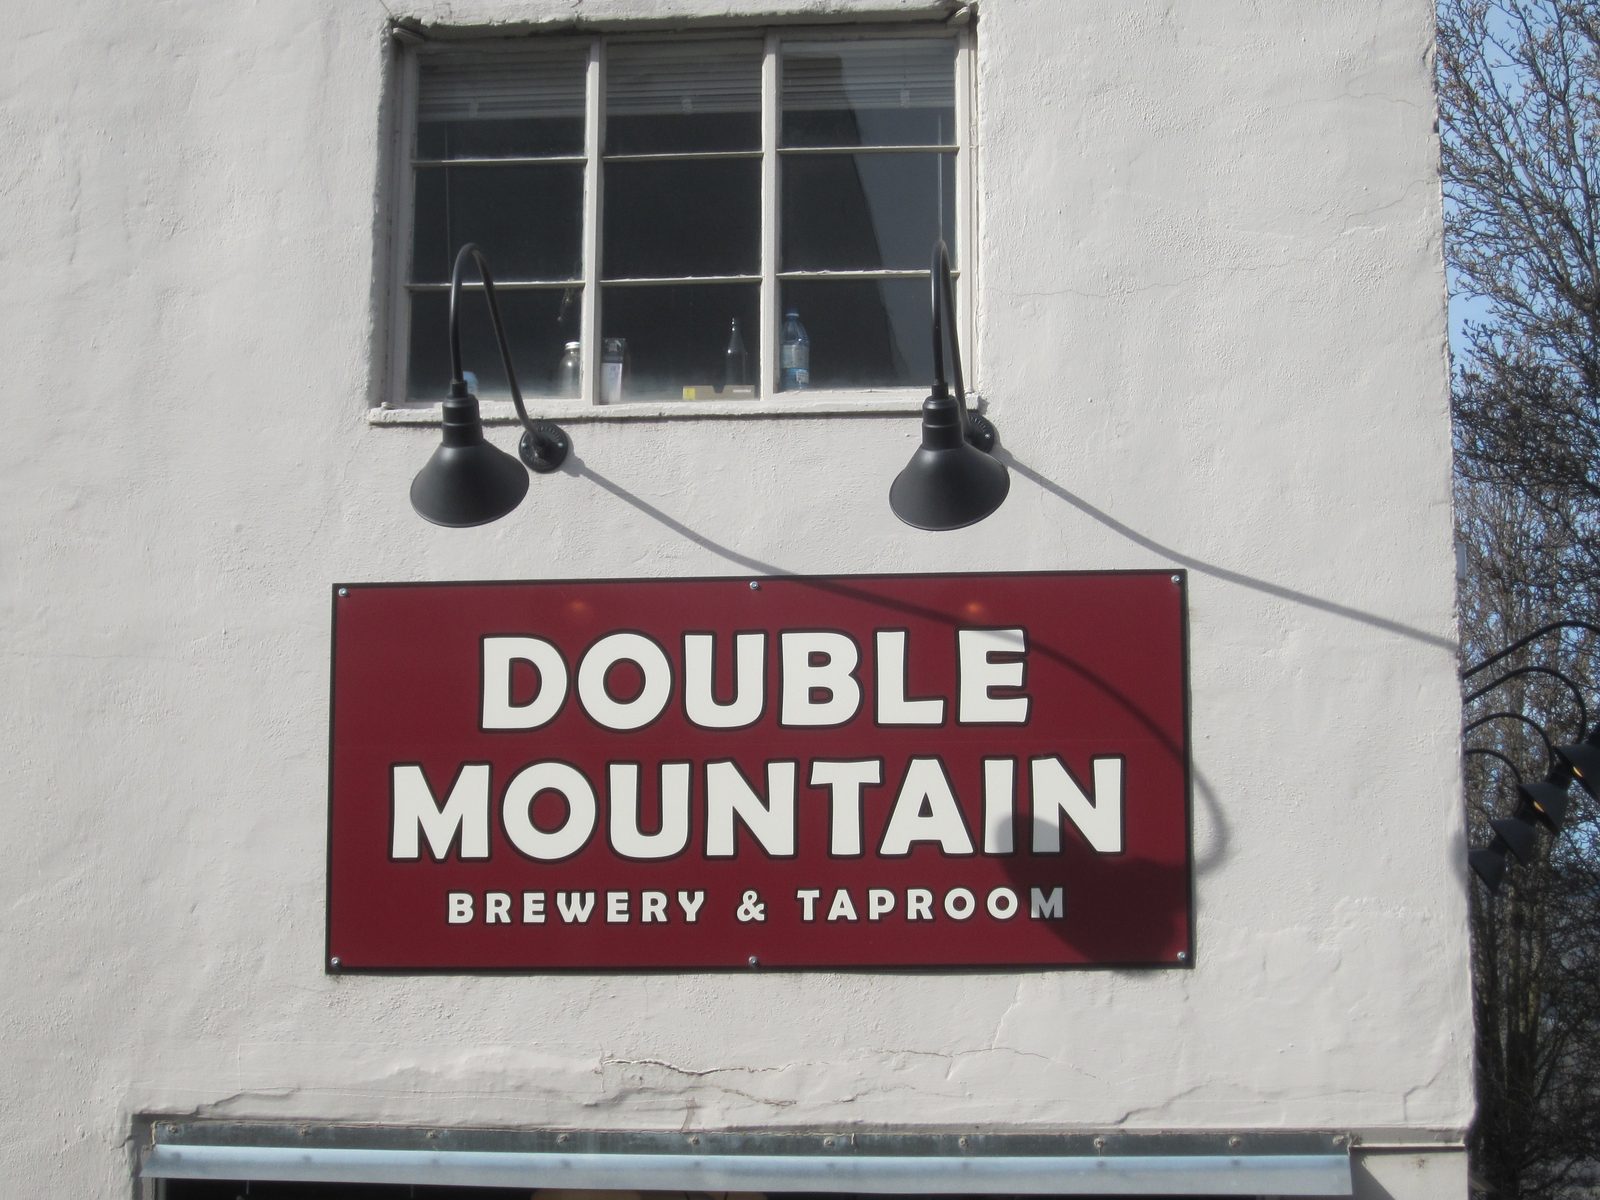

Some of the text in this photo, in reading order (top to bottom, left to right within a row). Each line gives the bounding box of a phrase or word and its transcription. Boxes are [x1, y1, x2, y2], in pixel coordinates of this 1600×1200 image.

[481, 628, 1029, 730] DOUBLE
[391, 757, 1122, 860] MOUNTAIN
[448, 887, 1064, 925] BREWERY & TAPROOM
